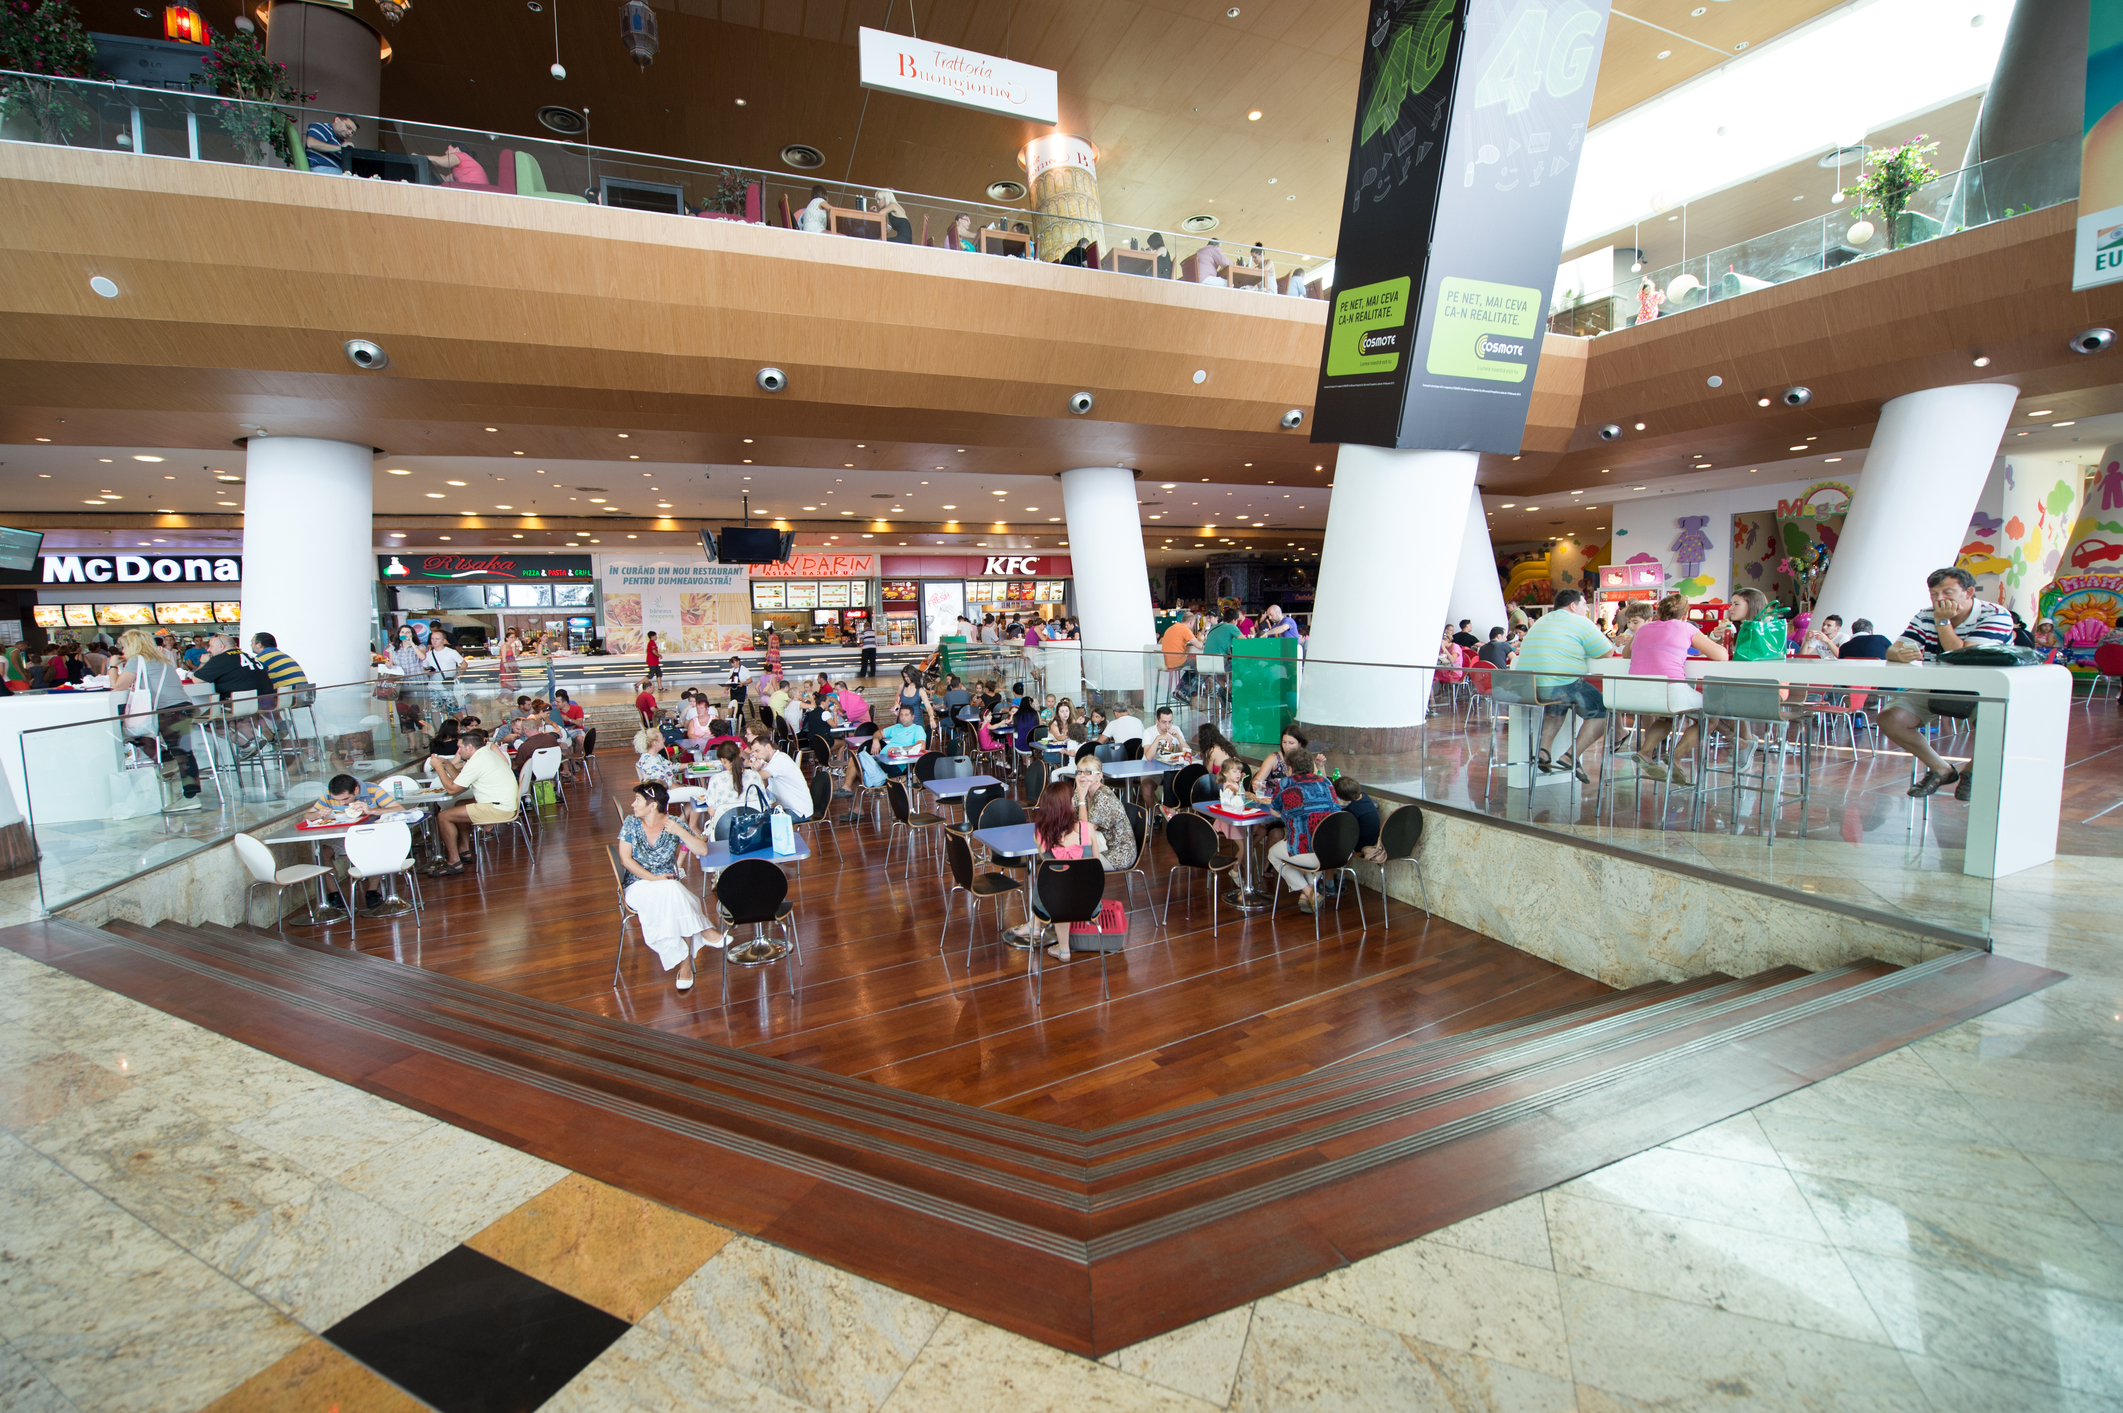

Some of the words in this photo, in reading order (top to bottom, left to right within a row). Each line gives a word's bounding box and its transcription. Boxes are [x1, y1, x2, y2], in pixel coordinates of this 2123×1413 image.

[933, 50, 993, 79] Trattoria
[1474, 10, 1602, 115] 4G
[897, 52, 1027, 104] Buongiorno
[1340, 302, 1349, 312] PE
[1350, 298, 1364, 310] NET,
[1365, 295, 1380, 306] MAI
[1380, 291, 1399, 303] CEVA
[1446, 290, 1459, 303] PE
[1462, 293, 1482, 307] NET,
[1485, 296, 1503, 308] MAI
[1505, 299, 1528, 312] CEVA
[1338, 315, 1354, 326] CA-N
[1354, 307, 1393, 322] REALITATE.
[1444, 305, 1468, 318] CA-N
[1470, 309, 1520, 326] REALITATE.
[1362, 335, 1396, 348] COSMOTE
[1481, 341, 1524, 356] COSMOTE
[1776, 498, 1849, 522] Magic
[42, 556, 243, 583] McDona
[423, 555, 517, 570] Risaka
[609, 565, 619, 575] ÎN
[621, 565, 655, 575] CURÂND
[658, 567, 670, 575] UN
[672, 567, 690, 575] NOU
[693, 567, 743, 575] RESTAURANT
[983, 557, 1038, 575] KFC
[623, 577, 655, 585] PENTRU
[657, 575, 732, 585] DUMNEAVOASTRĂ!
